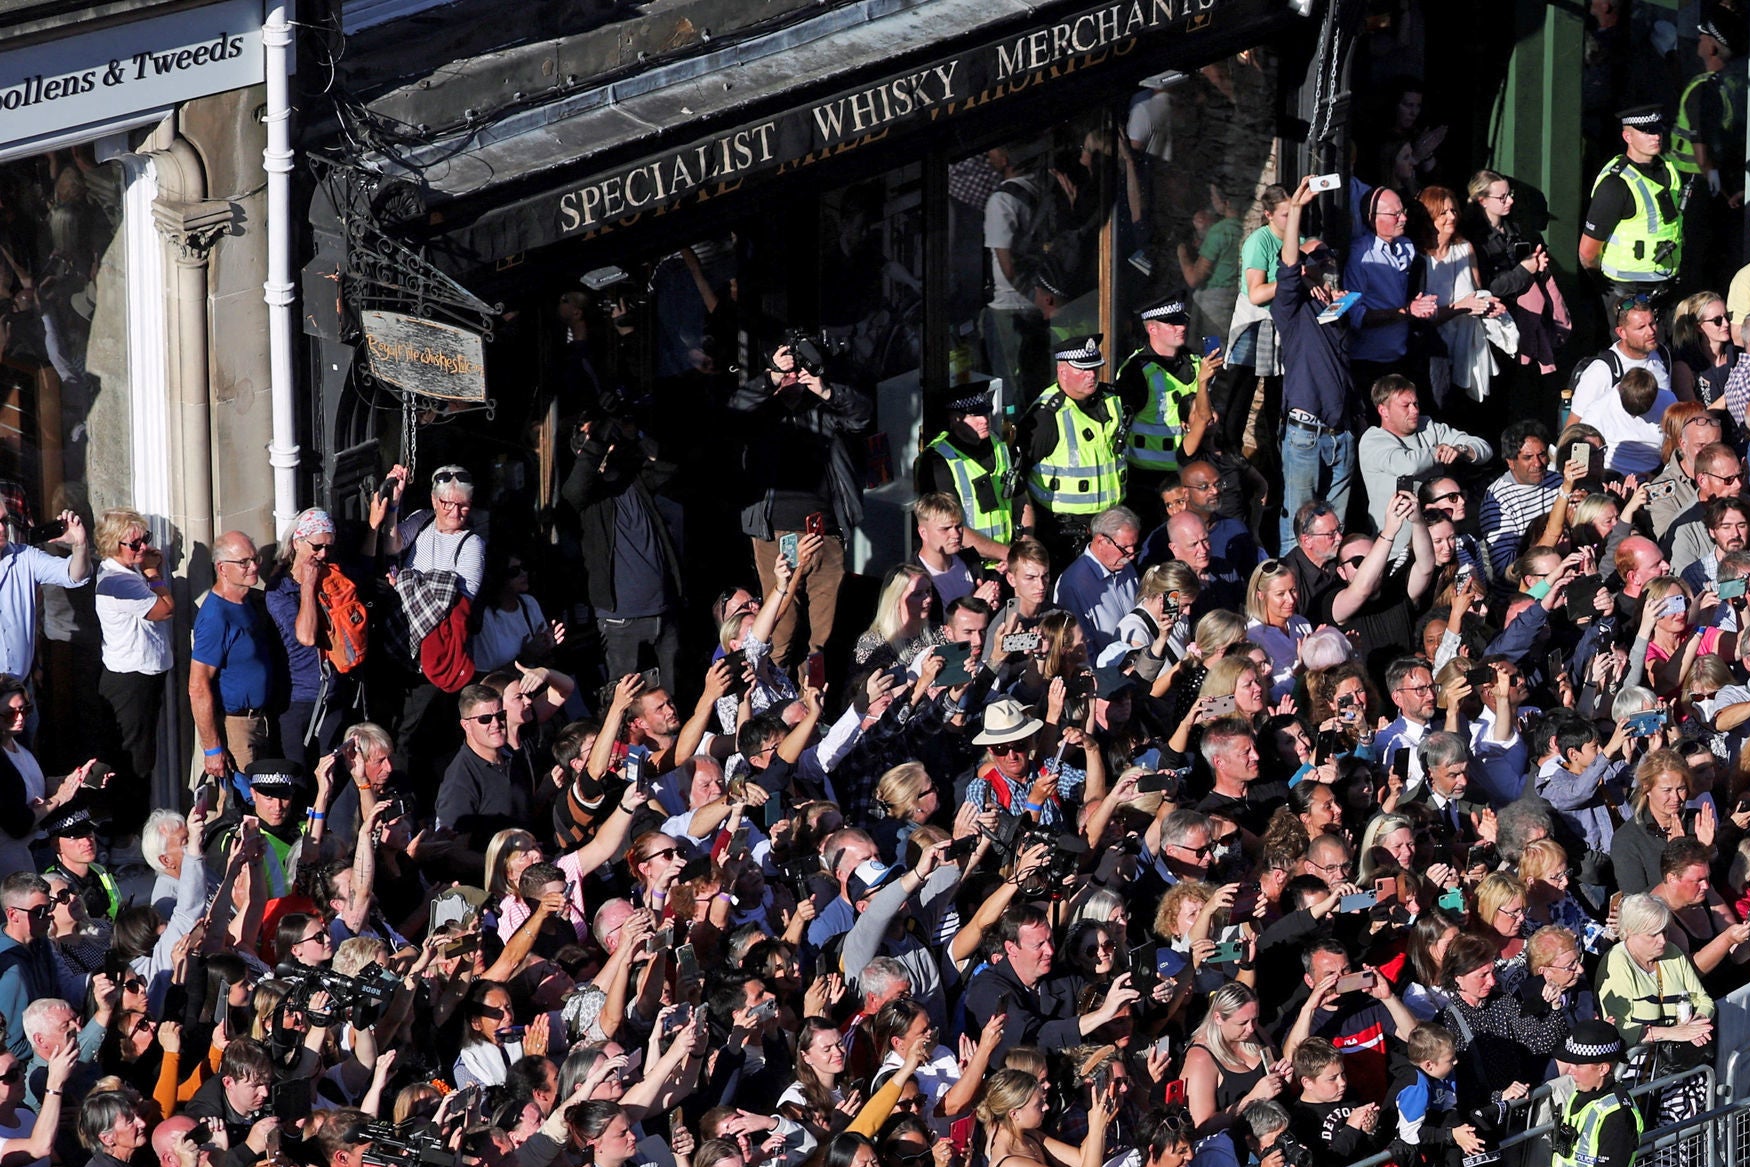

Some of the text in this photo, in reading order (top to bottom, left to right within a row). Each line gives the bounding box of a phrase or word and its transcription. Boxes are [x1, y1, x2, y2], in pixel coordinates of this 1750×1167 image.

[0, 32, 244, 110] ollens & Tweeds
[560, 121, 776, 232] SPECIALIST
[812, 60, 959, 142] WHISKY
